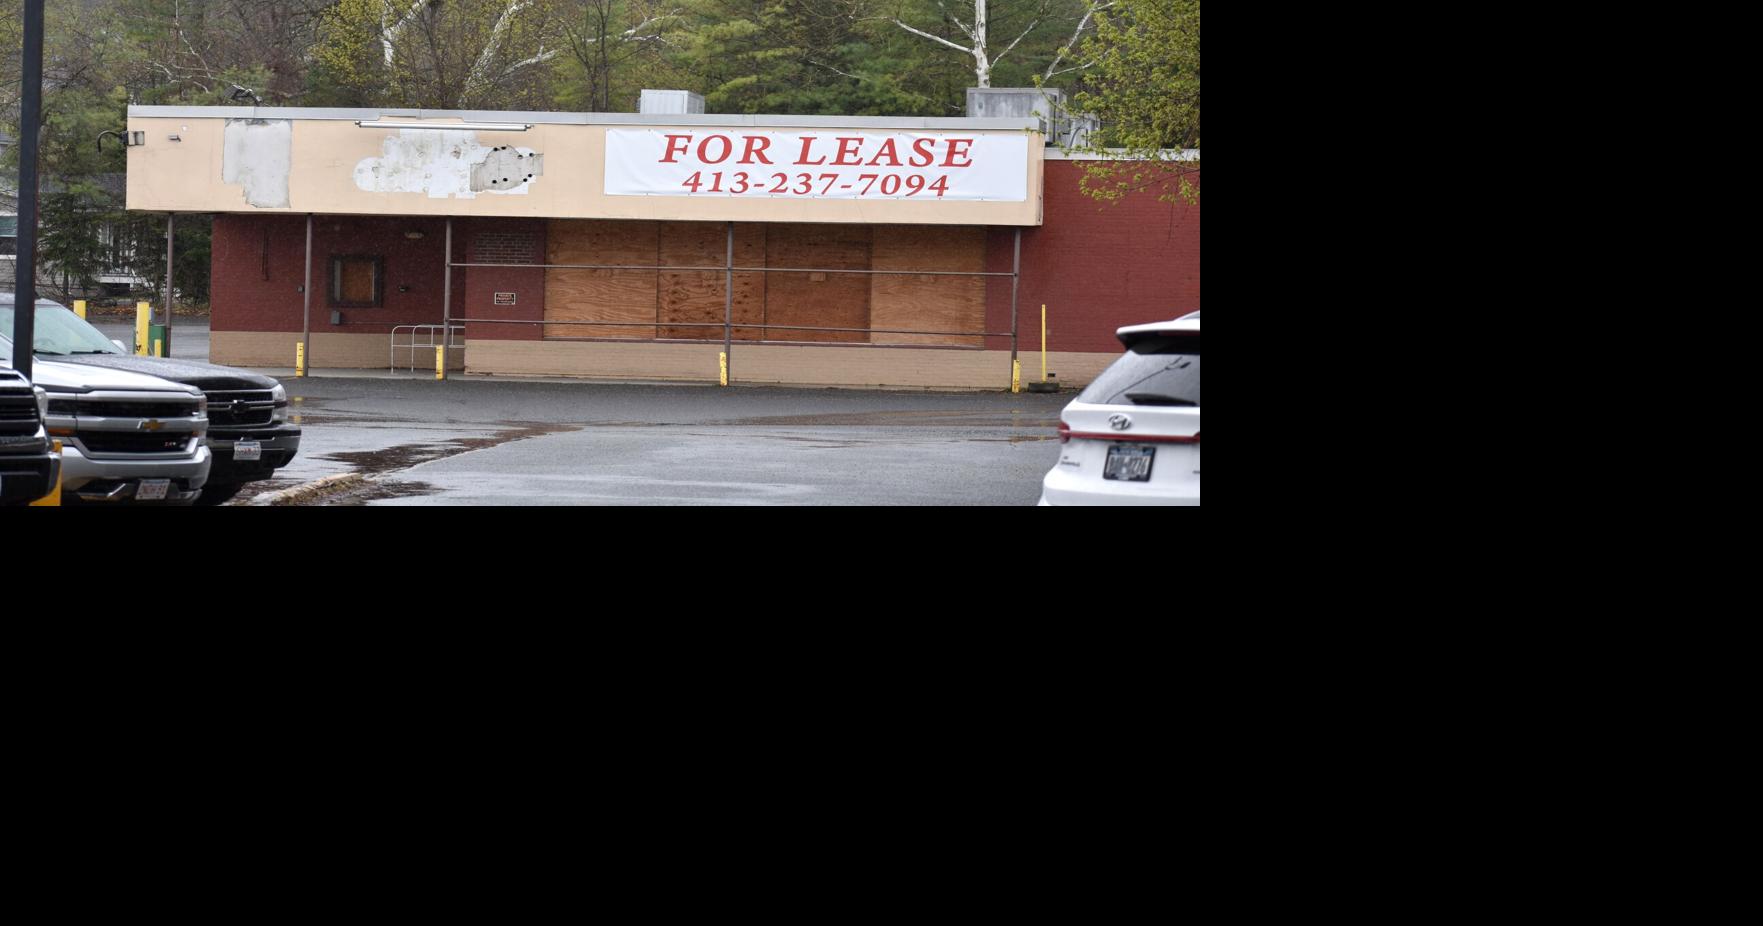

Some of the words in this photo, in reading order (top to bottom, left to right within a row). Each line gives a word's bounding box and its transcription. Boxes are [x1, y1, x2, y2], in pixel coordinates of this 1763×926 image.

[658, 134, 774, 165] FOR
[792, 136, 974, 168] LEASE
[681, 171, 949, 197] 413-237-7094
